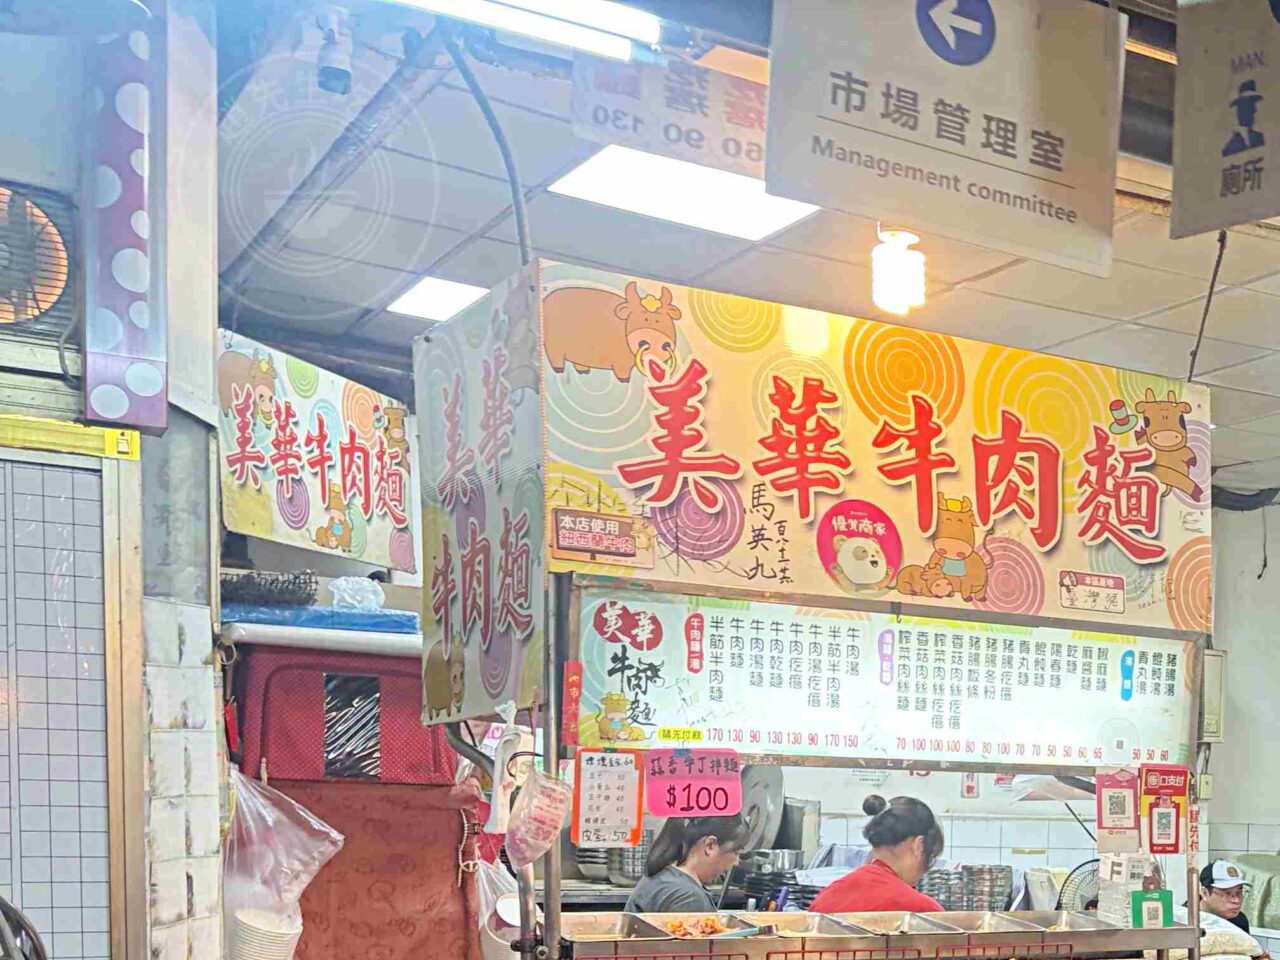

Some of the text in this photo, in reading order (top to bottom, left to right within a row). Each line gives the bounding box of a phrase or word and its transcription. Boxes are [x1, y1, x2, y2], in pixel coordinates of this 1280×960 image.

[830, 71, 1065, 172] 市場管理室
[811, 135, 1078, 224] Management committee
[226, 384, 408, 529] 美華牛肉麵
[616, 357, 1167, 562] 美華牛肉麵
[560, 515, 620, 535] 本店使用
[430, 509, 535, 660] 牛肉麵
[730, 617, 745, 668] 牛肉麵
[750, 618, 765, 687] 牛肉湯麵
[769, 620, 784, 688] 牛肉乾麵
[845, 626, 860, 676] 牛肉湯
[707, 728, 859, 747] 170 130 90 130 130 90 170 150
[897, 737, 906, 750] 70
[912, 738, 926, 751] 100
[930, 739, 943, 752] 100
[947, 740, 960, 752] 100
[997, 743, 1011, 755] 100
[1016, 743, 1025, 756] 70
[1032, 744, 1041, 756] 70
[1048, 745, 1057, 757] 50
[666, 783, 729, 811] $100
